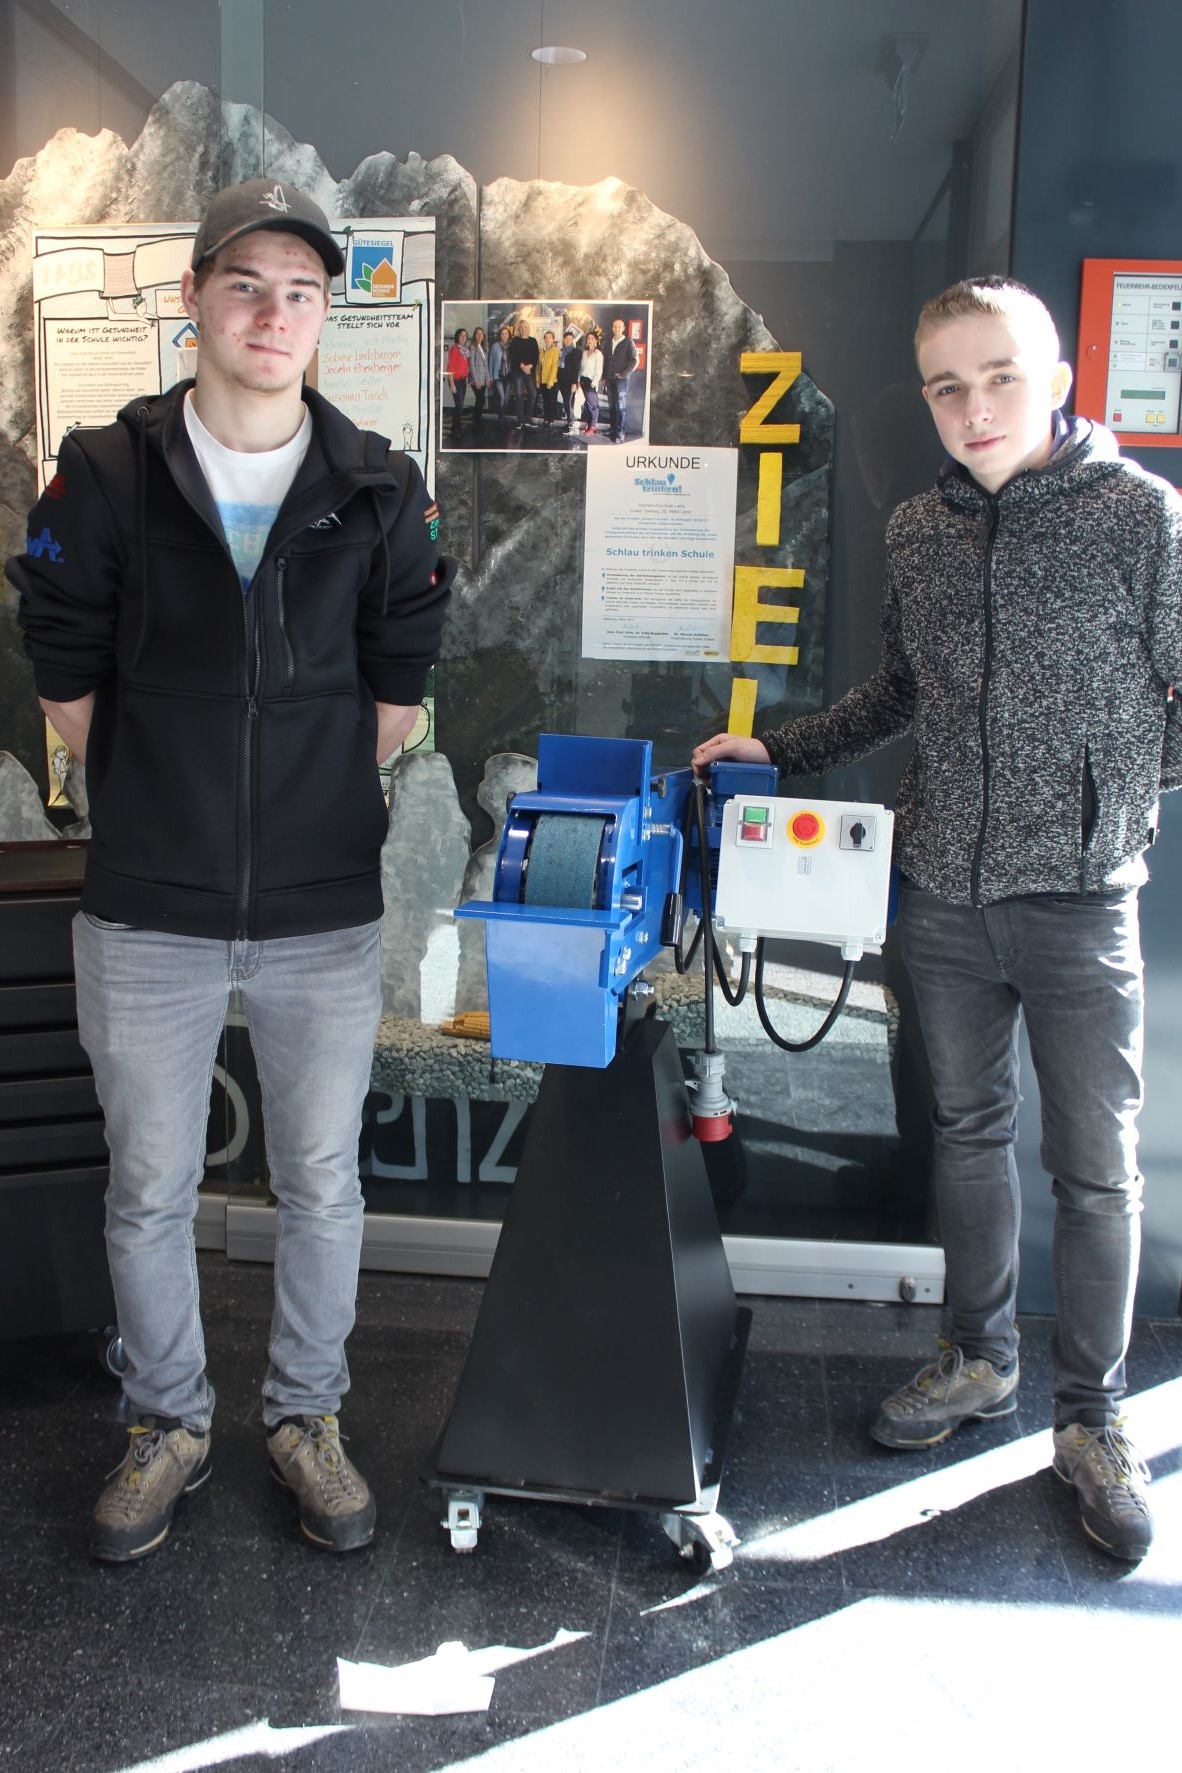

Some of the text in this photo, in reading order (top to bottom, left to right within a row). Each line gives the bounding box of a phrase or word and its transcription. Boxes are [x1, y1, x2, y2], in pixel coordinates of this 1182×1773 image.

[352, 239, 394, 247] GÜTESIEGEL
[112, 335, 149, 343] WICHTIG?
[626, 456, 701, 470] URKUNDE
[634, 478, 667, 486] Schlau
[642, 485, 683, 493] trinken!
[606, 547, 715, 559] Schlau trinken Schule
